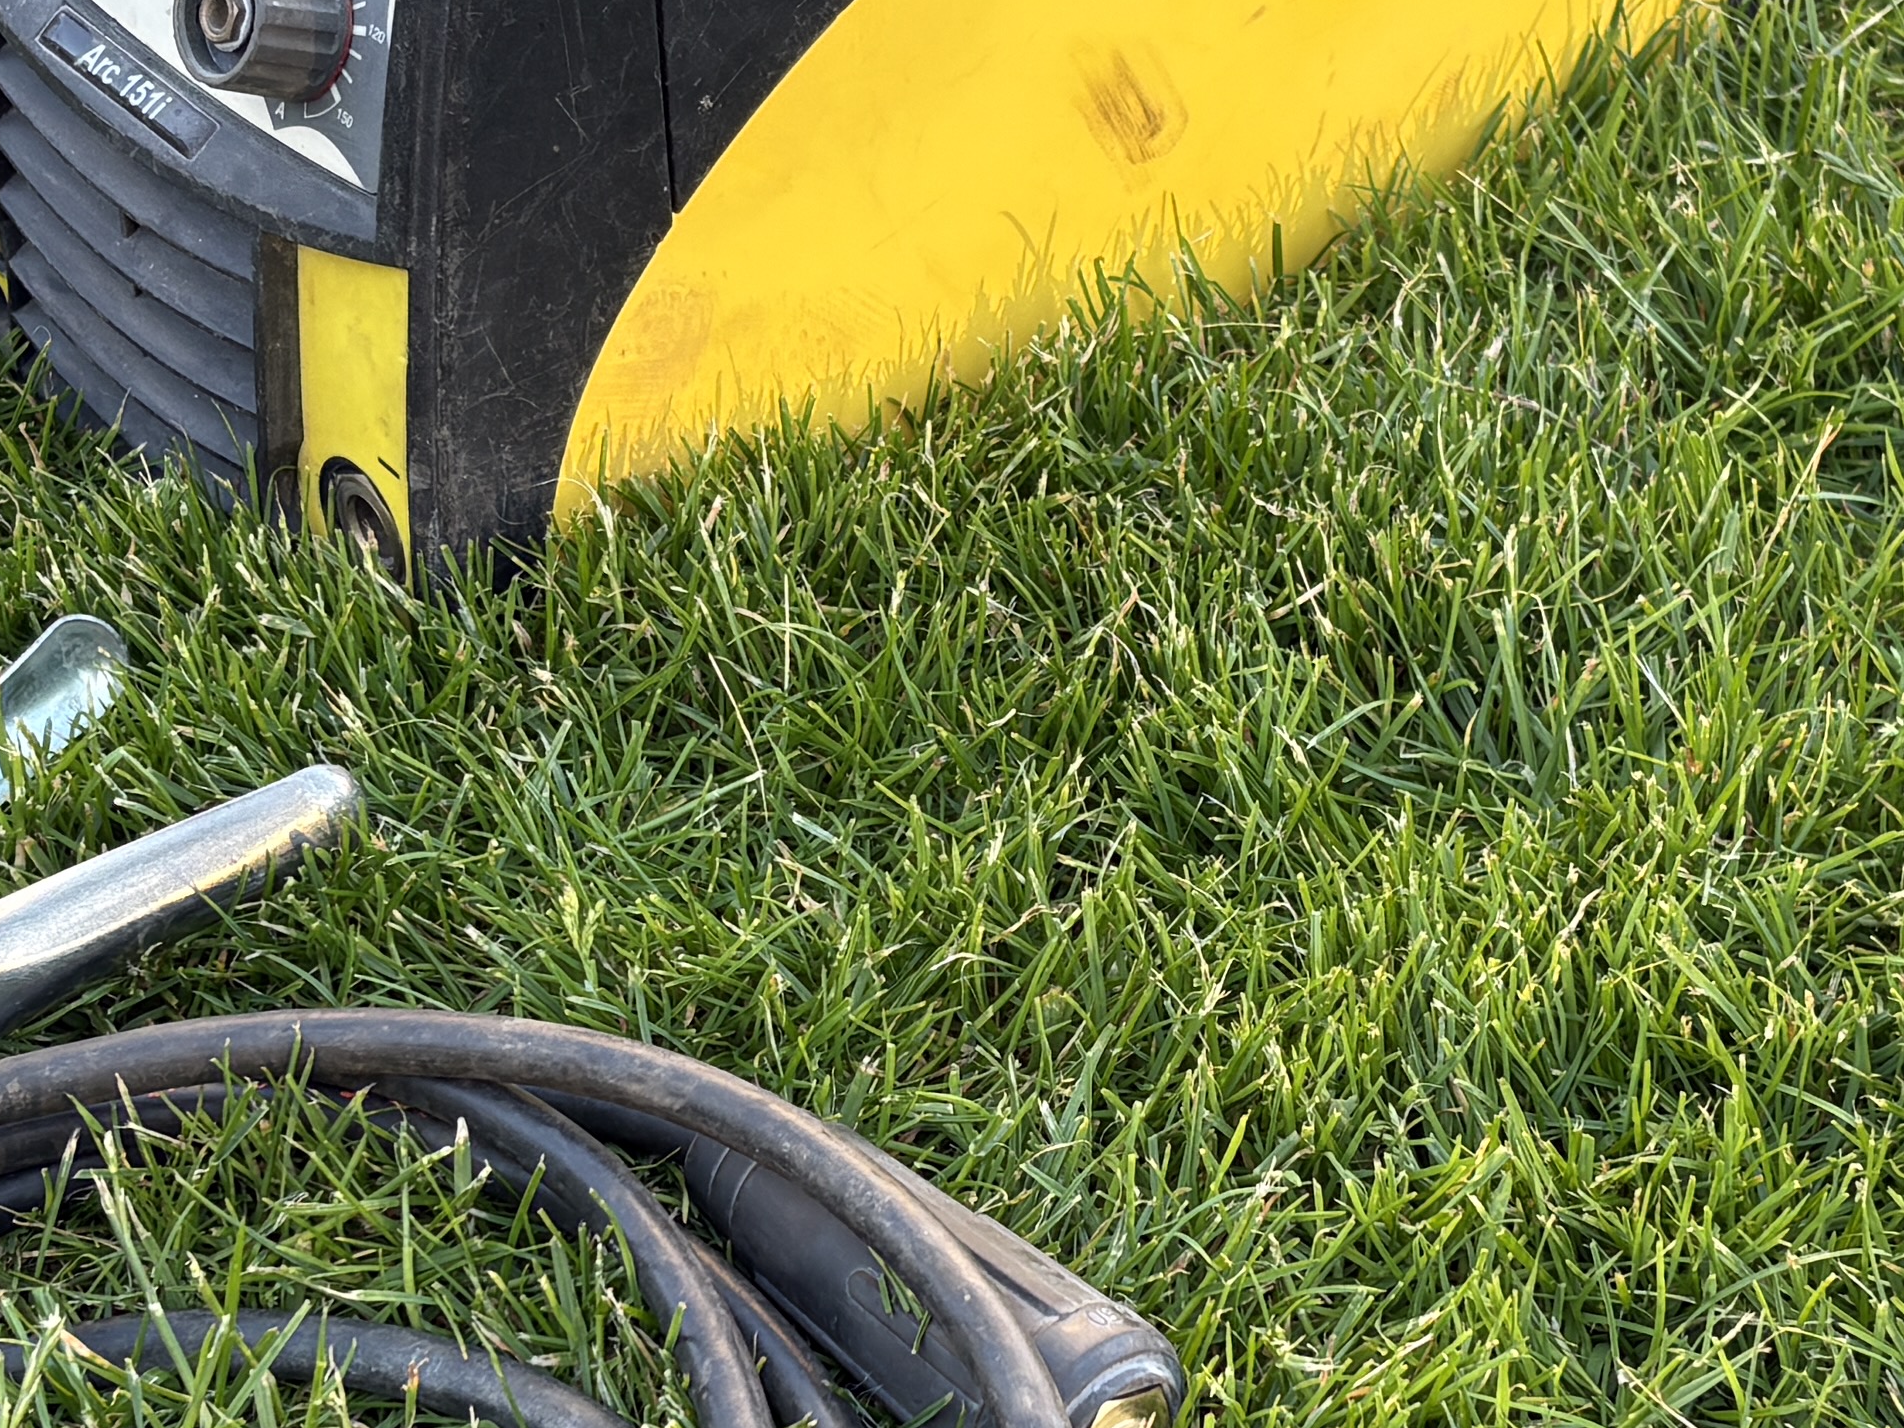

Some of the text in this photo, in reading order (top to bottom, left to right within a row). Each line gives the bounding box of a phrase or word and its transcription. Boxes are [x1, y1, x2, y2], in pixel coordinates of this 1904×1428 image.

[368, 24, 386, 44] 120
[74, 44, 173, 120] Arc 151i
[336, 108, 354, 128] 150
